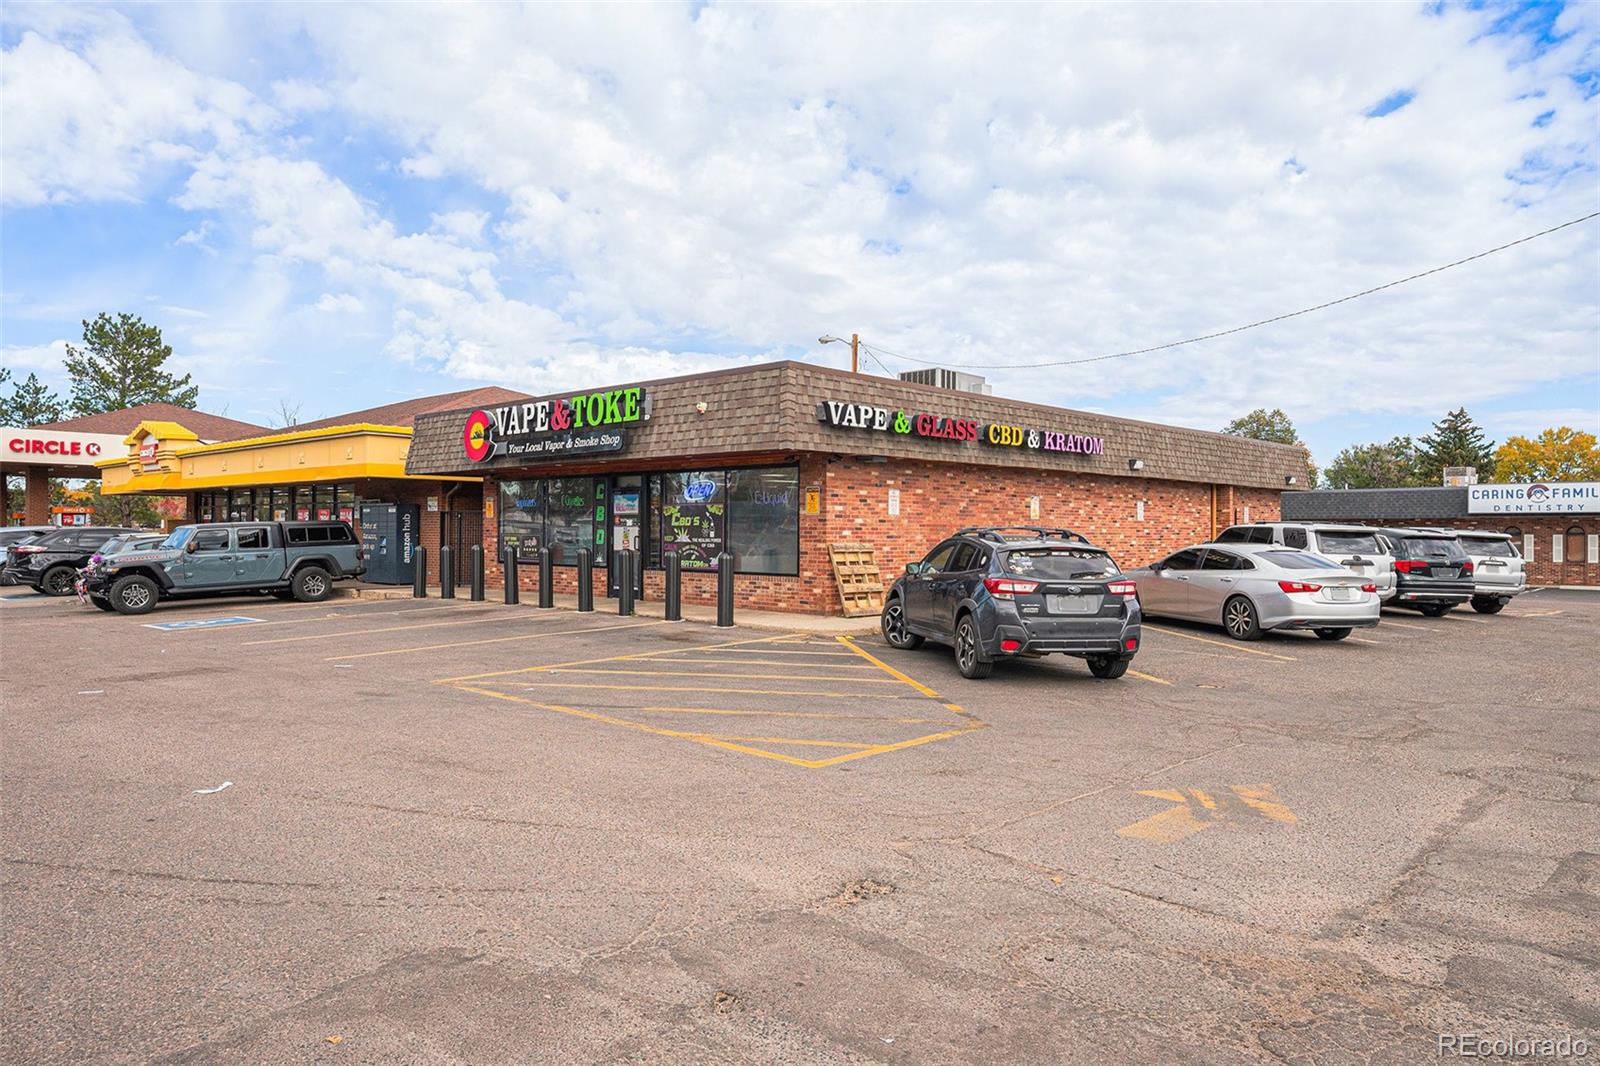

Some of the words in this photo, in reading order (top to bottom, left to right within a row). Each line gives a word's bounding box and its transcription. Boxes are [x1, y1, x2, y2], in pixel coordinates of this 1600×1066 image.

[496, 401, 549, 436] VAPE
[551, 400, 571, 430] &
[572, 387, 641, 428] TOKE
[827, 401, 888, 430] VAPE
[894, 409, 910, 434] &
[916, 413, 977, 440] GLASS
[988, 423, 1023, 446] CBD
[1027, 429, 1040, 449] &
[1043, 431, 1104, 455] KRATOM
[9, 439, 81, 456] CIRCLE
[508, 442, 525, 454] Your
[525, 440, 543, 452] Local
[544, 440, 565, 452] Vapor
[566, 438, 573, 449] &
[574, 435, 599, 448] Smoke
[600, 433, 620, 446] Shop
[687, 482, 712, 497] OPEN
[1472, 489, 1524, 500] CARING
[1552, 488, 1599, 499] FAMIL
[1493, 504, 1585, 512] DENTISTRY
[402, 513, 411, 531] hub
